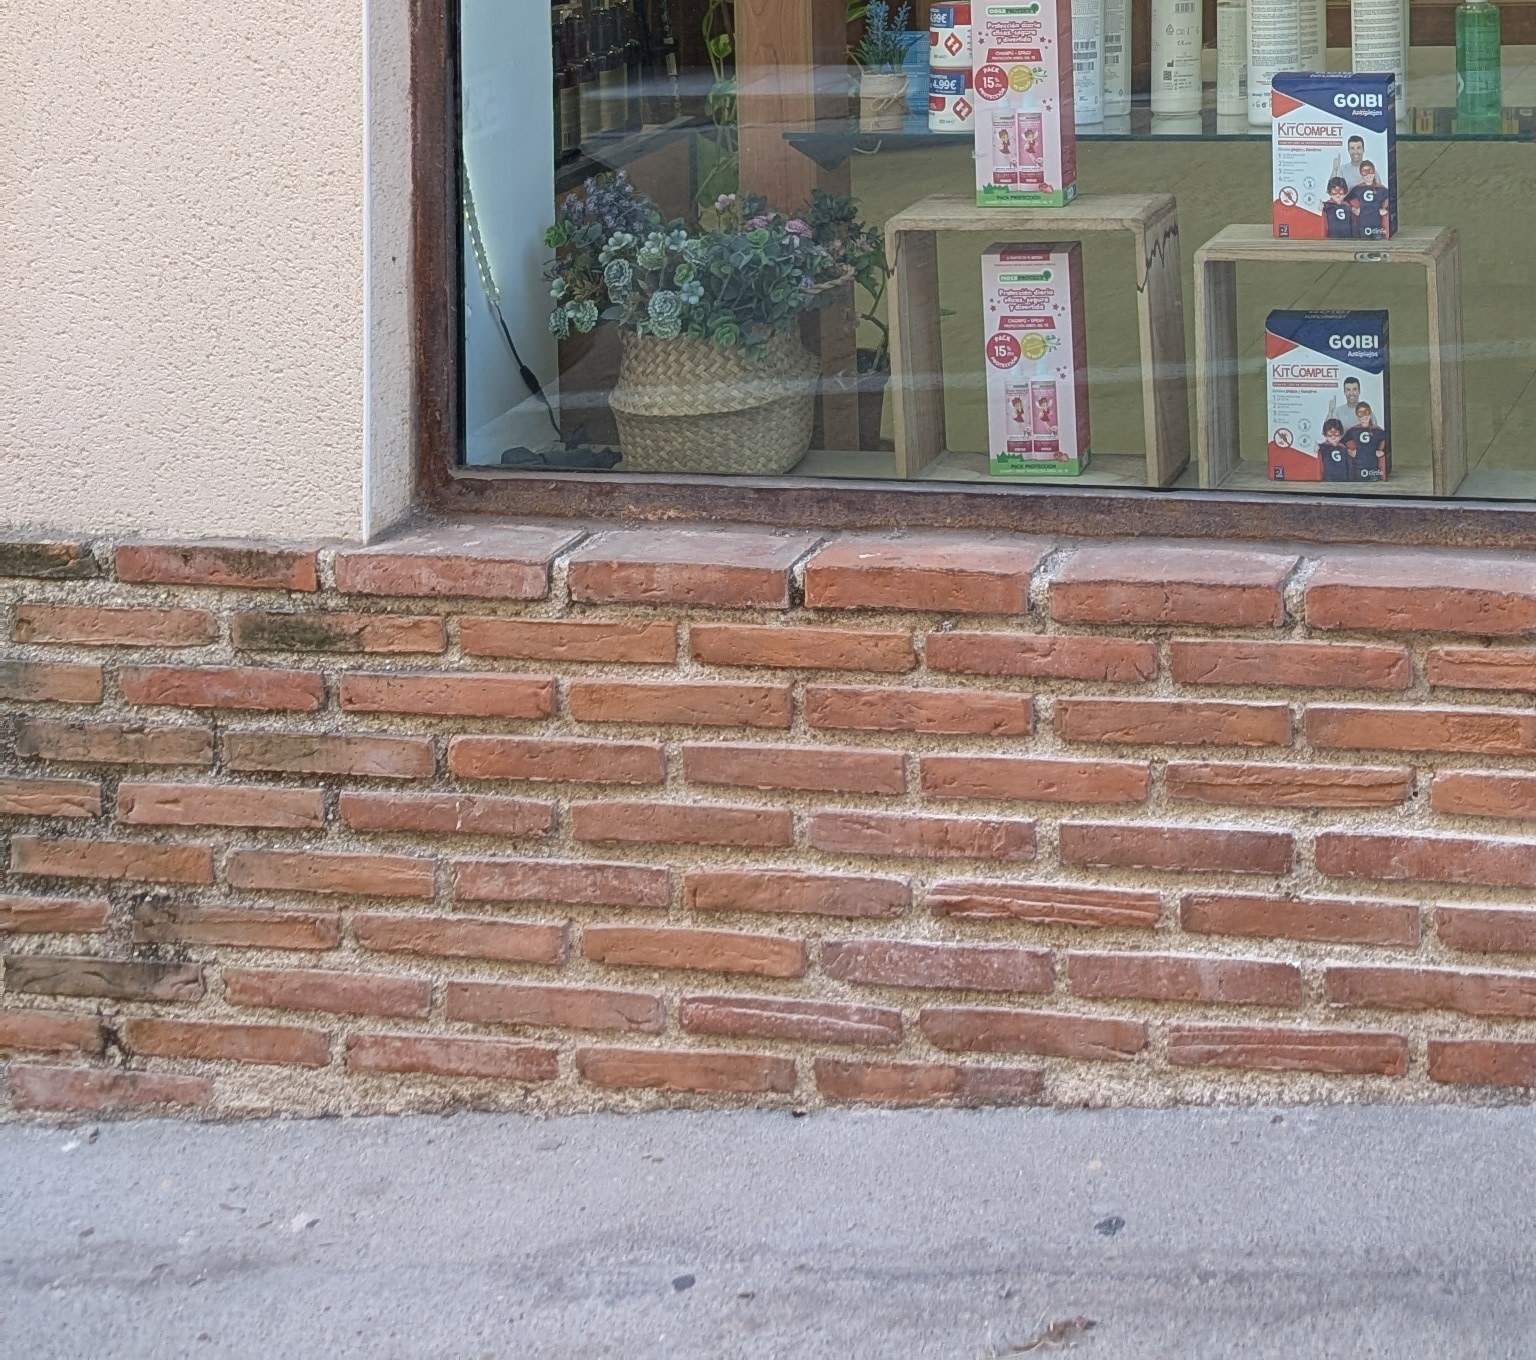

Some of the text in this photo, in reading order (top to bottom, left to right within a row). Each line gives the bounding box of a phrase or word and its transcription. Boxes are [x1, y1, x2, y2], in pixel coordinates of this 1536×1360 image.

[982, 76, 996, 89] 15
[1333, 93, 1383, 108] GOIBI
[1328, 334, 1379, 349] GOIBI
[993, 345, 1007, 357] 15
